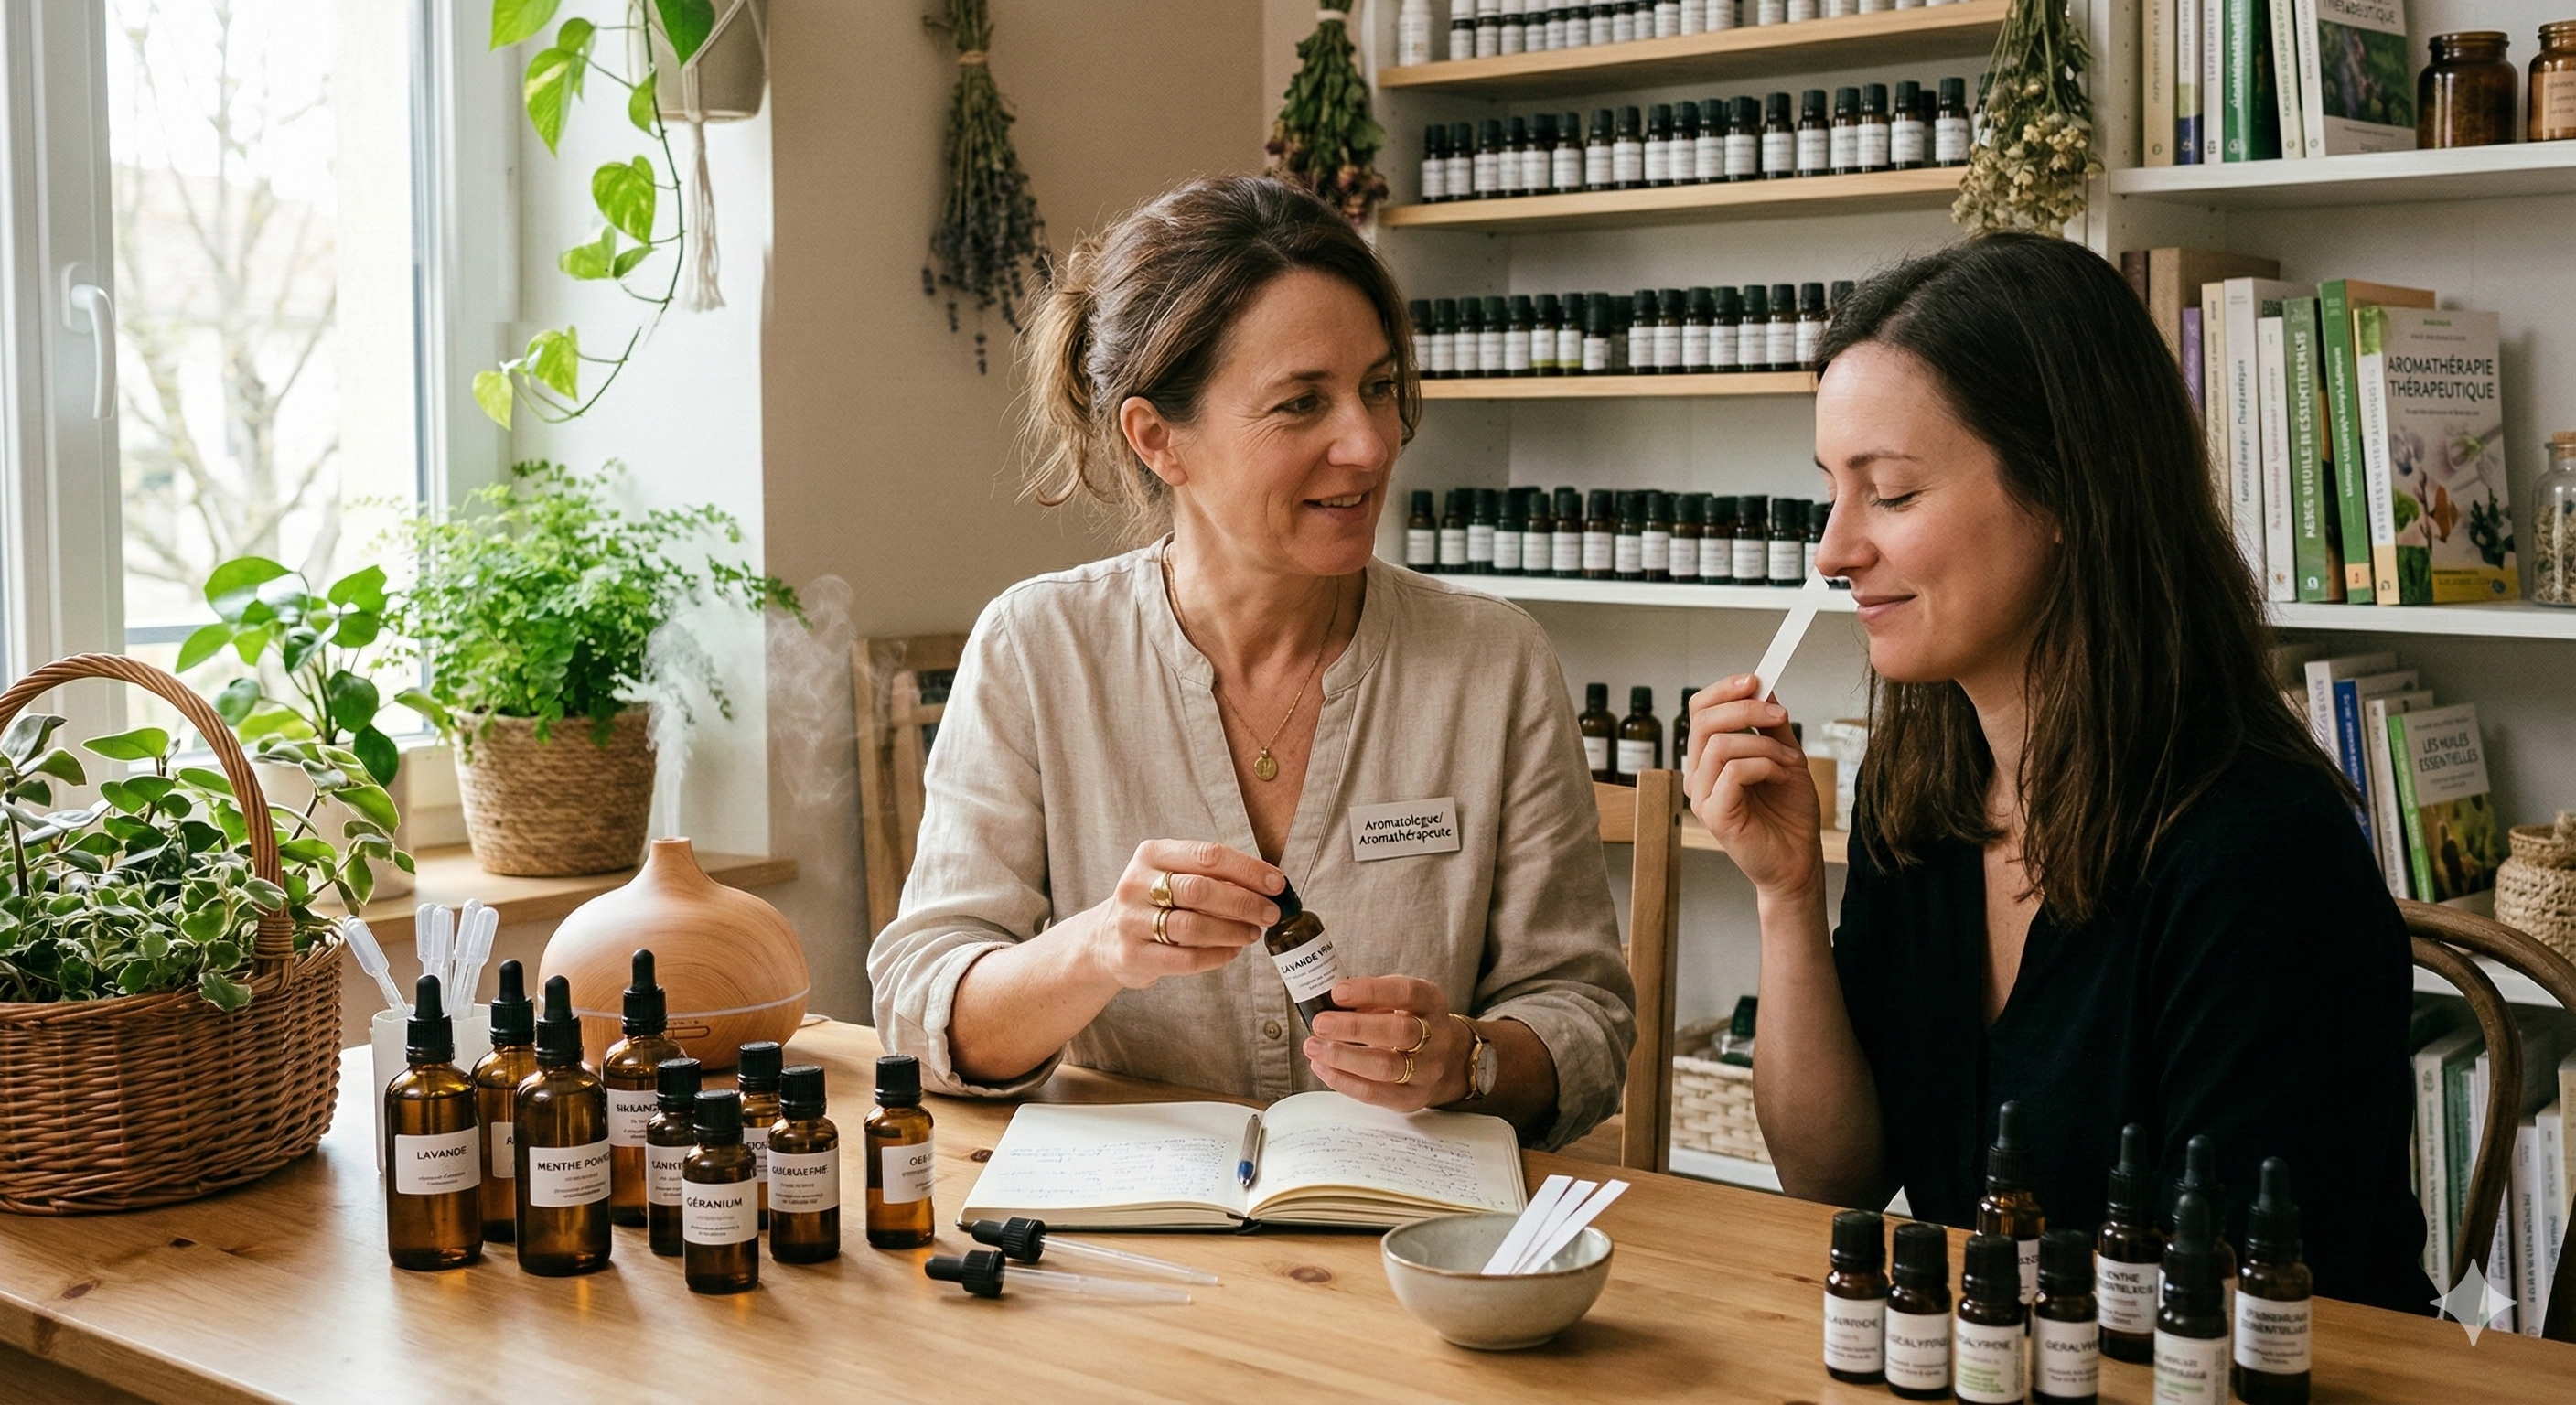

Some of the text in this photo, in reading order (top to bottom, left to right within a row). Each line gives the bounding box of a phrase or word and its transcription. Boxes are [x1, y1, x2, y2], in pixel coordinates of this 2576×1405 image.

[2388, 354, 2494, 376] AROMATHÉRAPIE
[2388, 376, 2495, 402] THÉRAPEUTIQUE
[537, 1161, 583, 1172] MENTHE
[686, 1196, 743, 1209] GÉRANIUM
